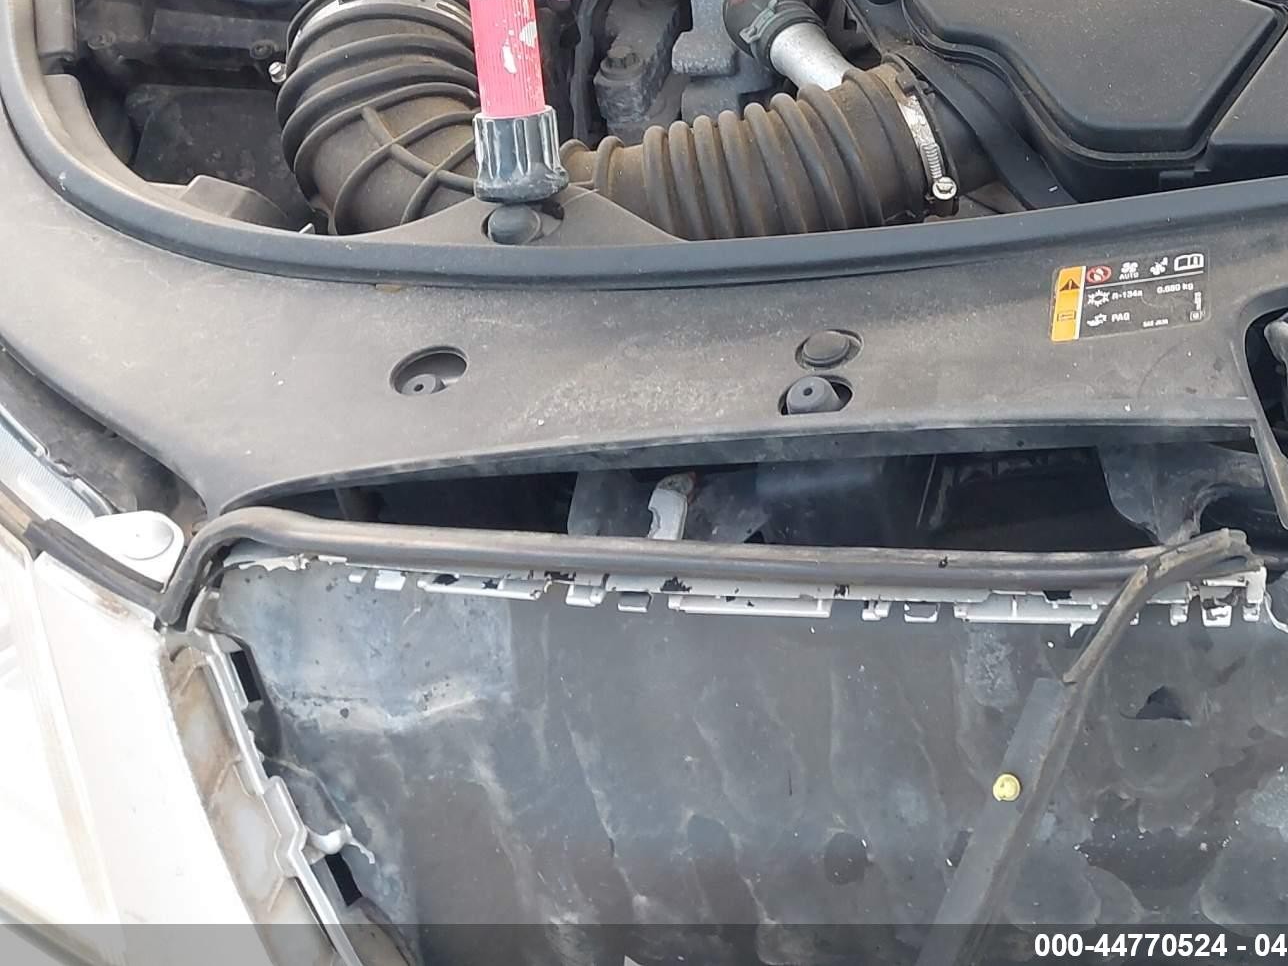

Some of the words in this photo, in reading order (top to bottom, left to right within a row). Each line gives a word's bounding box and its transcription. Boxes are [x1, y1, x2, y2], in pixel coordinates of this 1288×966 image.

[1119, 272, 1139, 280] AUTO
[1182, 282, 1194, 291] kg
[1111, 290, 1143, 300] R-134a
[1111, 311, 1130, 322] PAG
